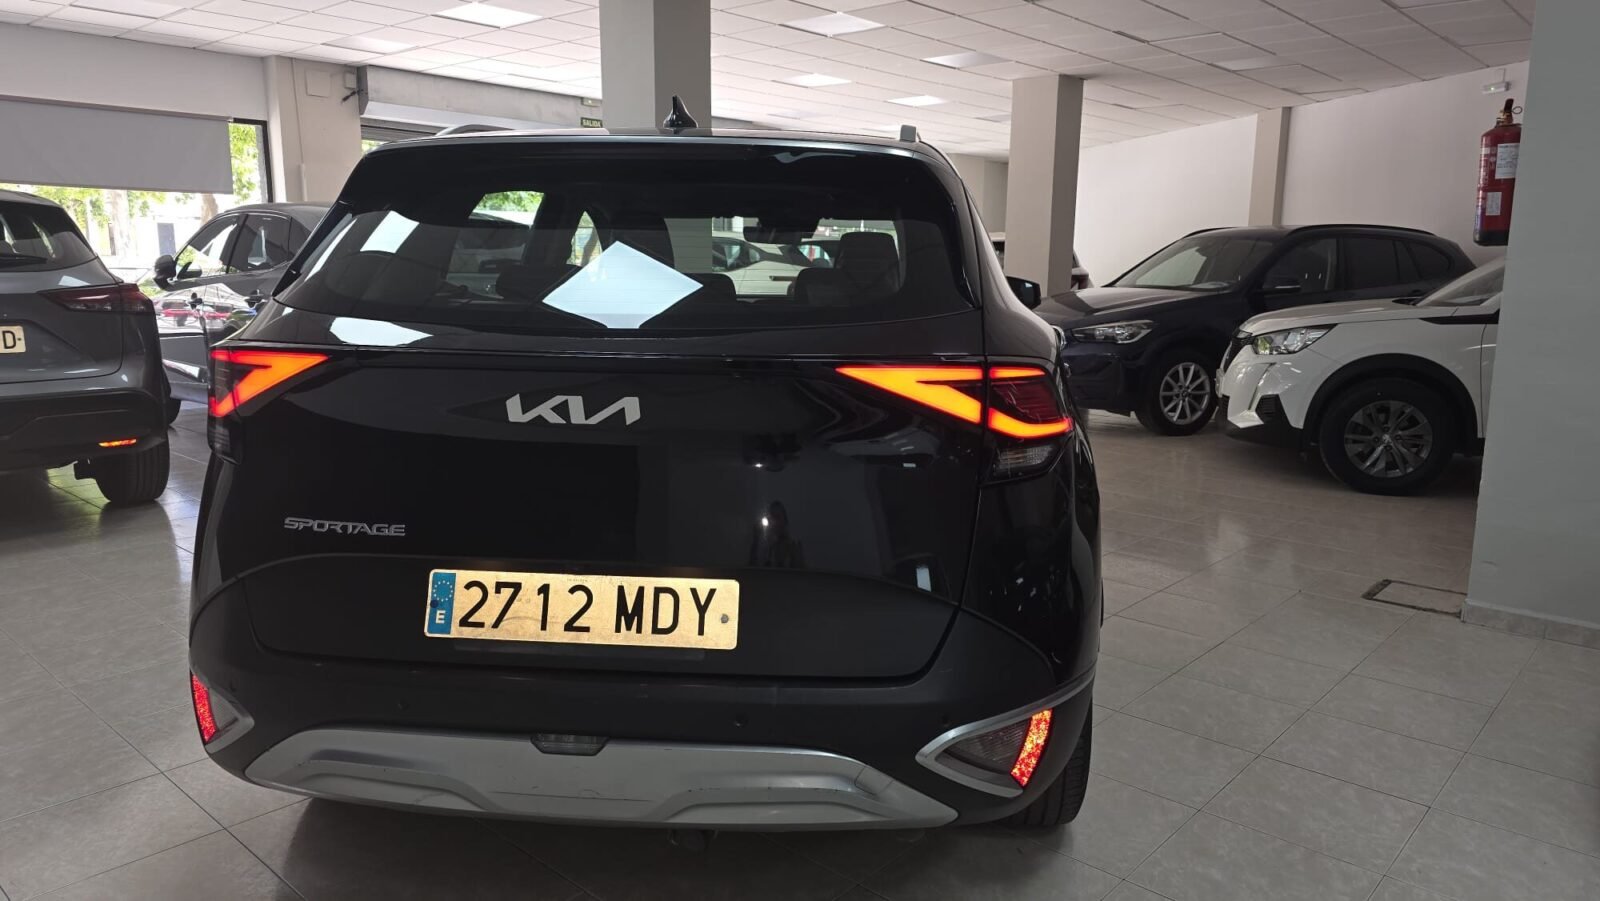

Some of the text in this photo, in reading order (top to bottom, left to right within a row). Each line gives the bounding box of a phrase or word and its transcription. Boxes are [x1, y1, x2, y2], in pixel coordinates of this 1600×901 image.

[582, 119, 601, 127] SALIDA
[284, 516, 406, 536] SPORTAGE
[458, 580, 717, 636] 2712 MDY
[435, 610, 445, 624] E
